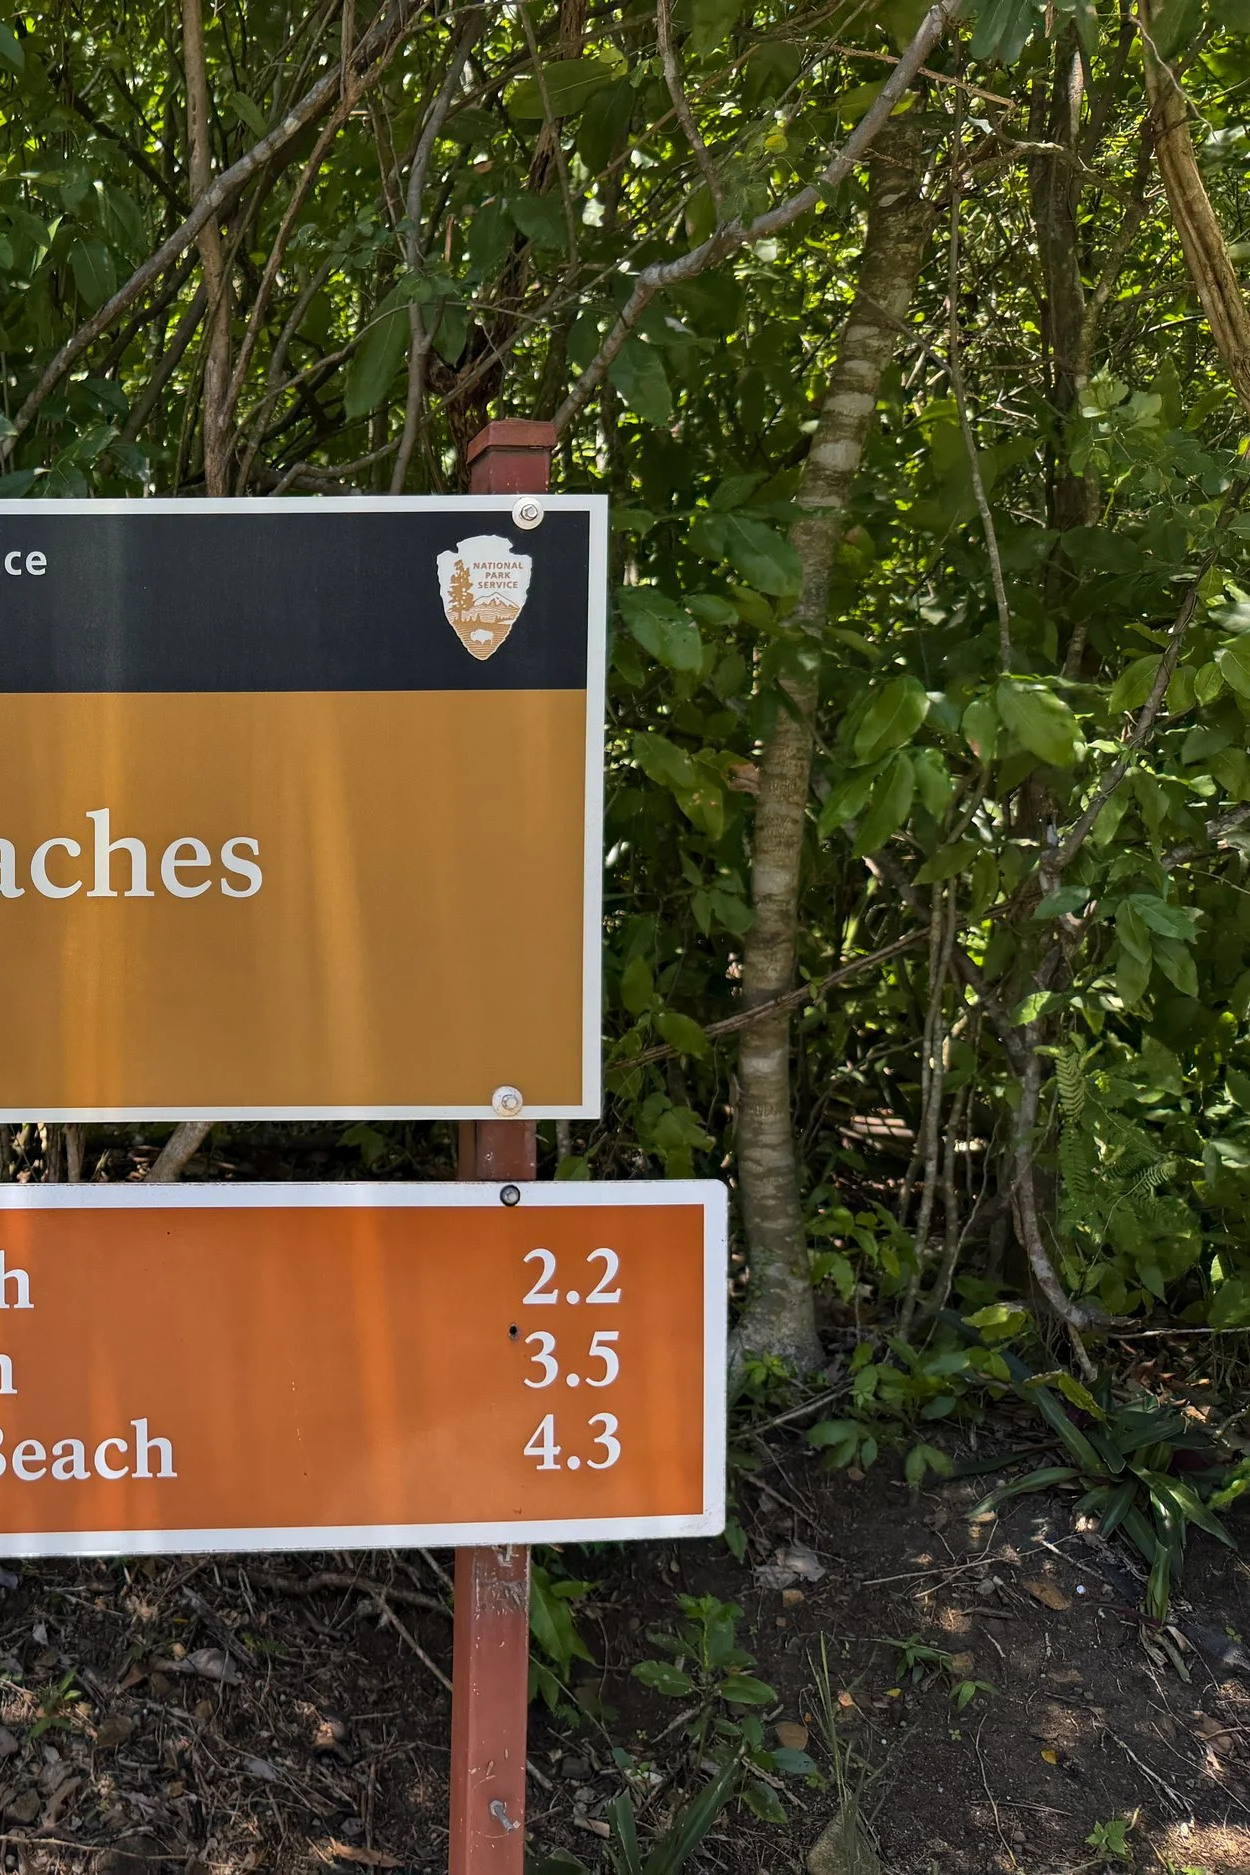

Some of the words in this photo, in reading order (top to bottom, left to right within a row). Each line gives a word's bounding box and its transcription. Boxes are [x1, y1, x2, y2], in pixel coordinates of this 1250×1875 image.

[473, 562, 523, 570] NATIONAL
[478, 581, 518, 589] SERVICE
[522, 1247, 622, 1305] 2.2
[523, 1330, 621, 1389] 3.5
[523, 1412, 622, 1471] 4.3
